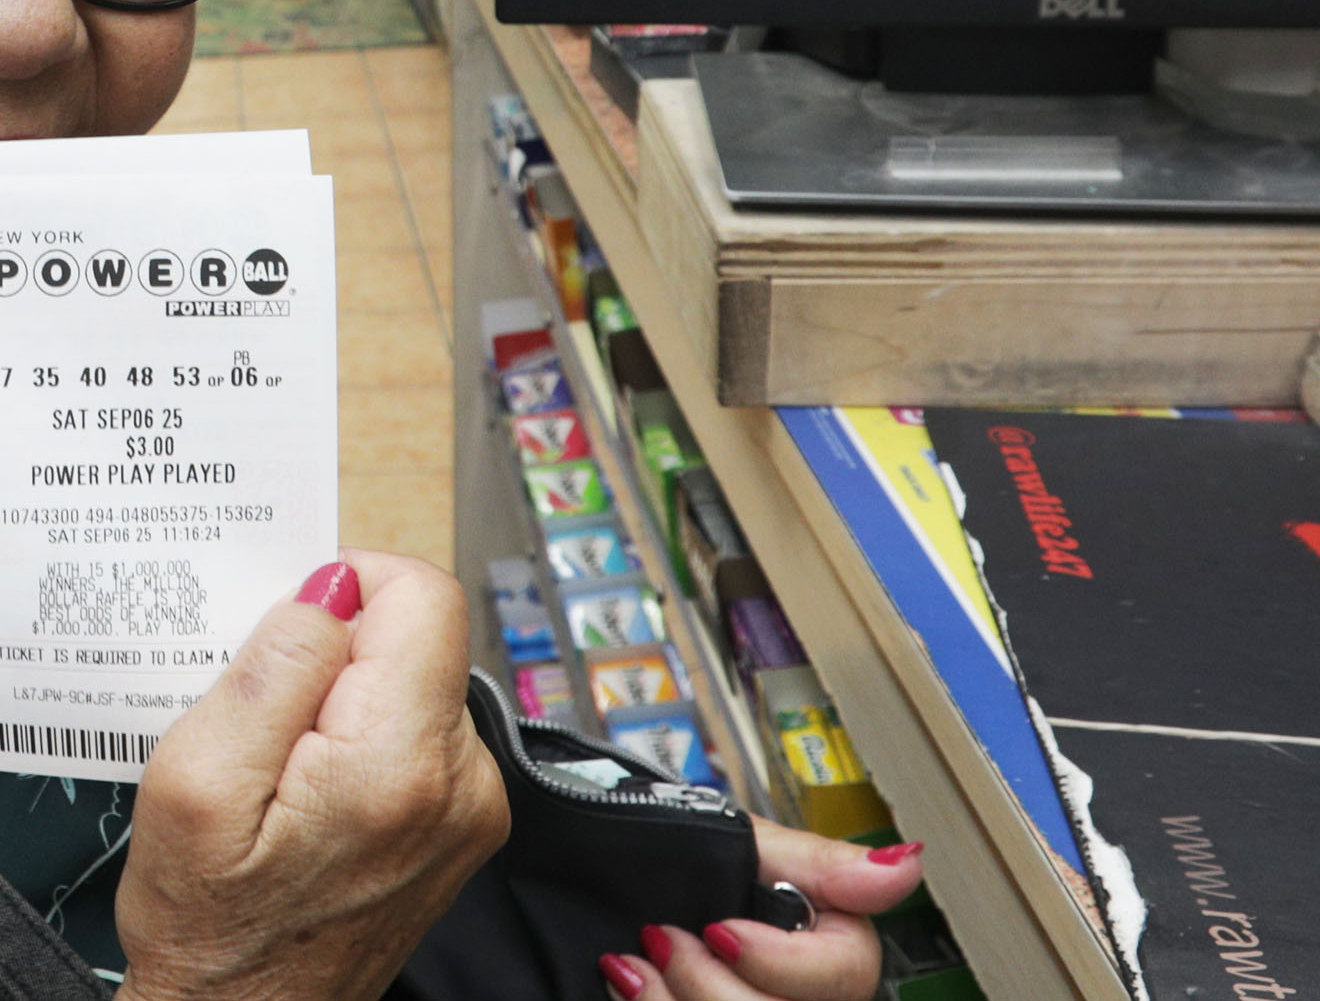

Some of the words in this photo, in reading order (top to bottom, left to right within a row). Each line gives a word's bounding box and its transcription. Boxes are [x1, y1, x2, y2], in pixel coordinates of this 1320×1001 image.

[32, 230, 84, 244] YORK
[234, 350, 250, 366] PB
[33, 367, 60, 388] 35
[80, 367, 107, 388] 40
[127, 367, 154, 387] 48
[173, 367, 200, 387] 53
[231, 367, 258, 387] 06
[52, 408, 89, 430] SAT
[97, 408, 154, 430] SEP06
[162, 408, 183, 429] 25
[126, 435, 174, 459] $3.00
[31, 464, 100, 486] POWER
[108, 464, 155, 485] PLAY
[163, 463, 236, 484] PLAYED
[2, 508, 79, 526] 10743300
[48, 528, 78, 545] SAT
[84, 528, 130, 544] SEP06
[136, 527, 152, 543] 25
[163, 526, 222, 543] 11:16:24
[47, 562, 80, 579] WITH
[89, 561, 105, 577] 15
[113, 575, 136, 592] THE
[144, 575, 200, 591] MILLION
[39, 591, 88, 607] DOLLAR
[96, 591, 144, 607] RAFFLE
[153, 590, 169, 606] IS
[177, 589, 208, 606] YOUR
[40, 606, 71, 622] BEST
[80, 606, 112, 622] ODDS
[120, 606, 135, 621] OF
[144, 605, 201, 621] WINNING
[129, 621, 161, 636] PLAY
[53, 647, 69, 664] IS
[75, 648, 142, 666] REQUIRED
[150, 649, 166, 665] TO
[173, 649, 215, 666] CLAIM
[221, 648, 231, 665] A
[1160, 815, 1297, 1001] www.rawt
